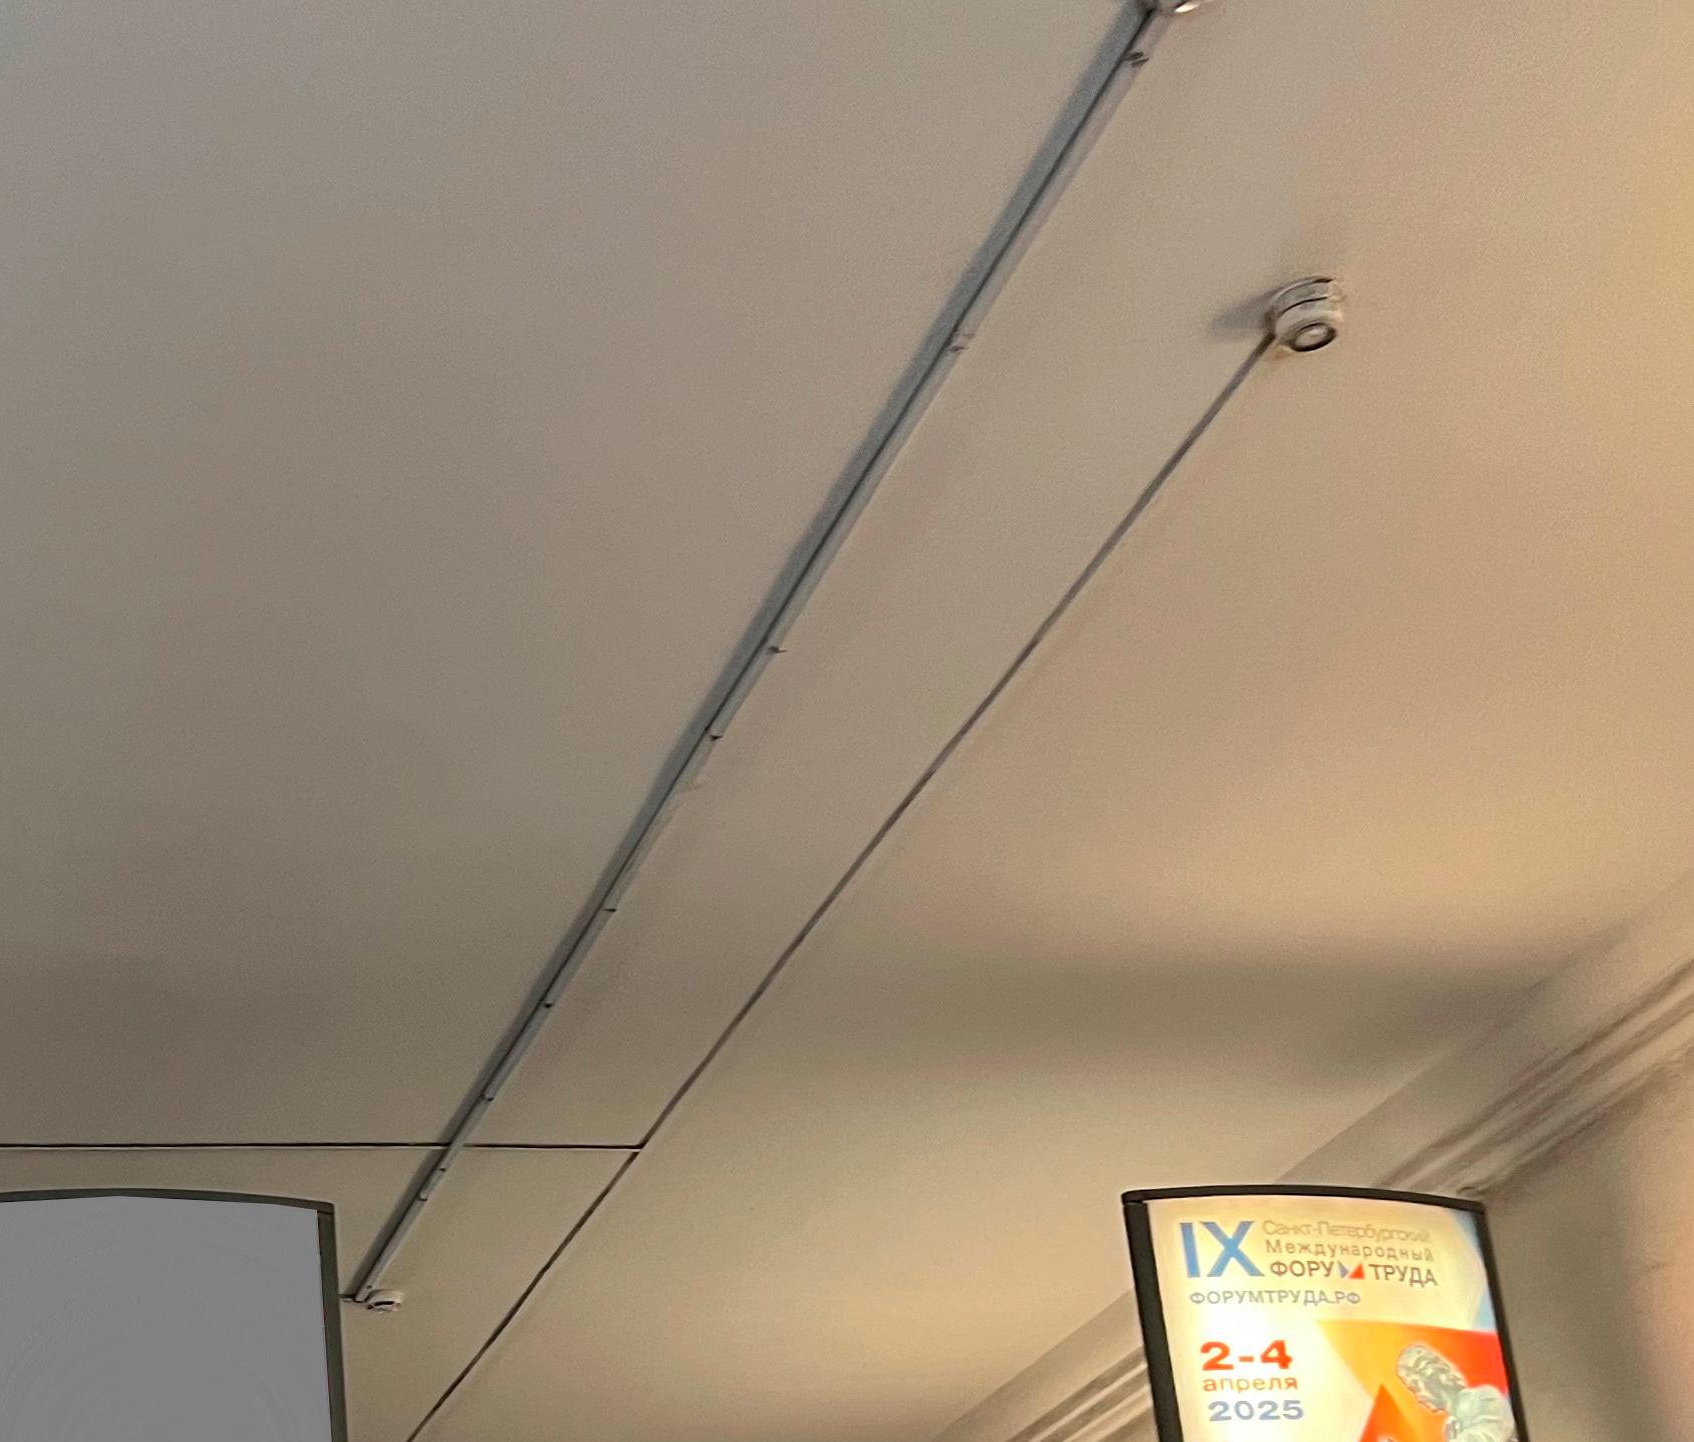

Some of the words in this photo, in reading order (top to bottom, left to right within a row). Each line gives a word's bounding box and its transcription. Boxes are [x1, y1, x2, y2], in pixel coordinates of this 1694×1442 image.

[1179, 1220, 1264, 1278] IX
[1265, 1239, 1435, 1262] Международный
[1368, 1263, 1439, 1288] ТРУДА
[1200, 1339, 1293, 1371] 2-4
[1202, 1376, 1298, 1394] апреля
[1207, 1399, 1305, 1421] 2025
